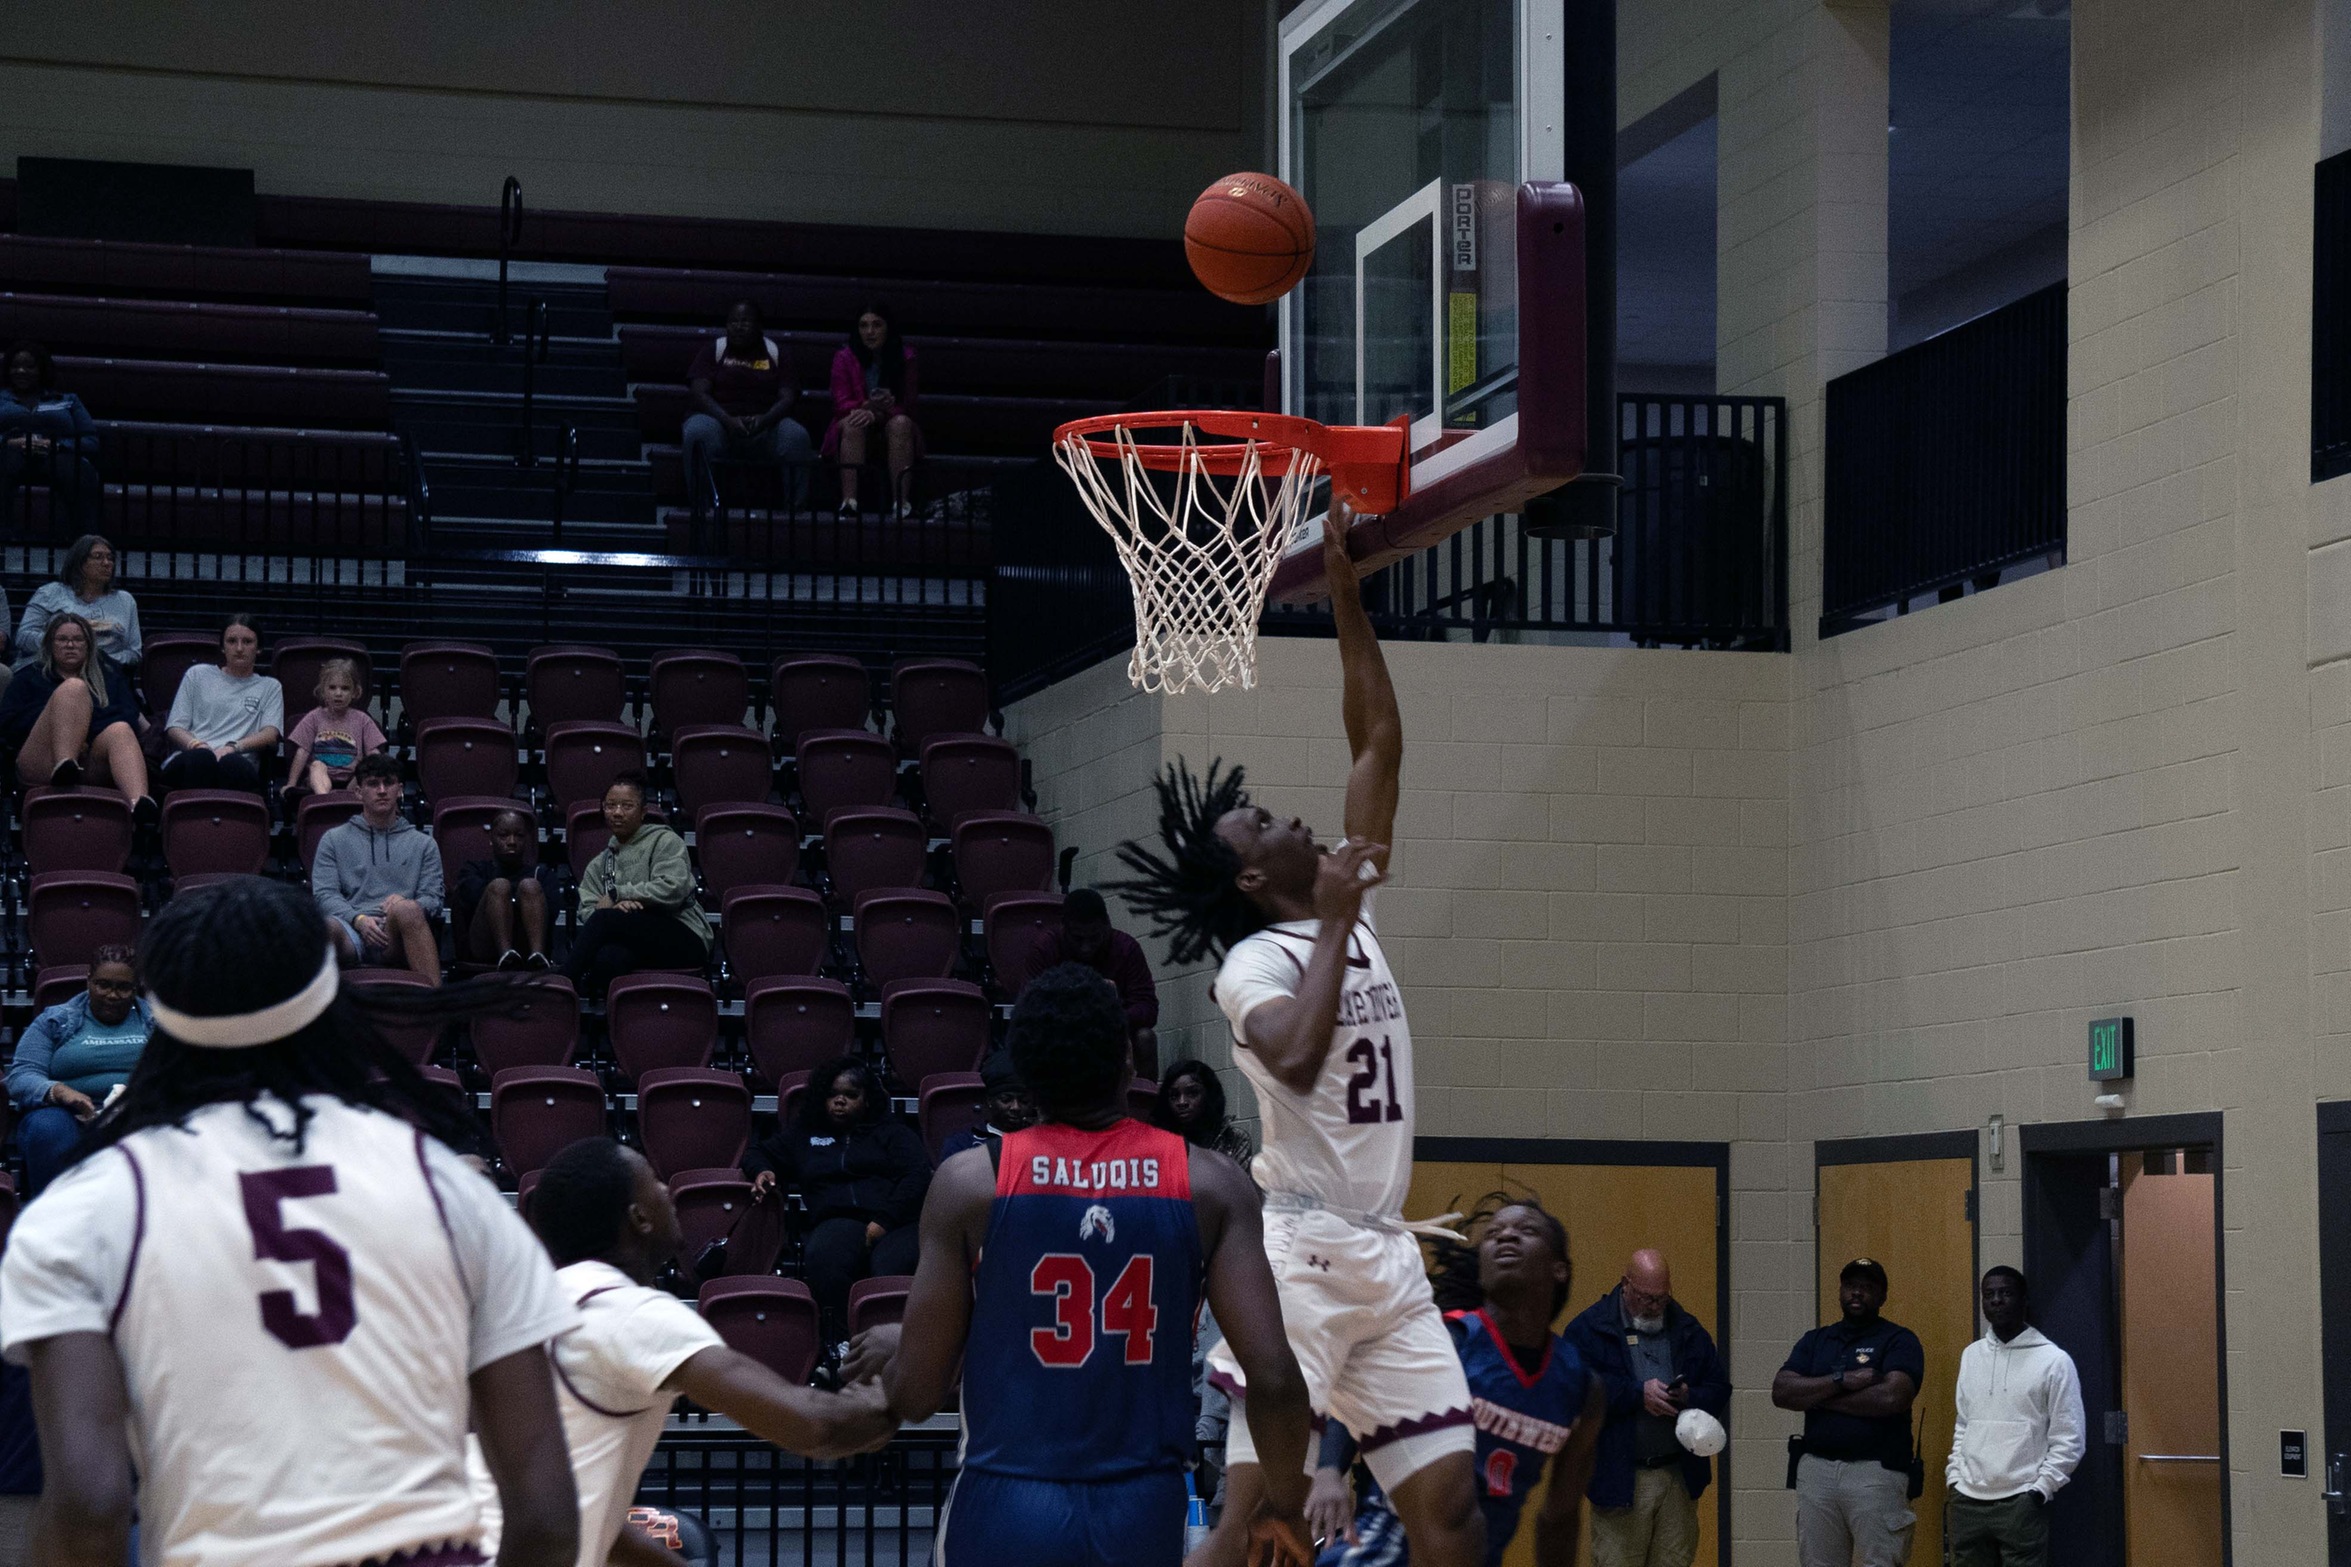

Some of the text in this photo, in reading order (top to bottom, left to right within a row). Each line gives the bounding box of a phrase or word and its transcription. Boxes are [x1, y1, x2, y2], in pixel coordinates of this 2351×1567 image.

[1346, 1034, 1403, 1124] 21
[2094, 1024, 2117, 1071] EXIT
[1032, 1155, 1159, 1190] SALUQIS
[238, 1165, 359, 1349] 5
[1030, 1252, 1159, 1368] 34
